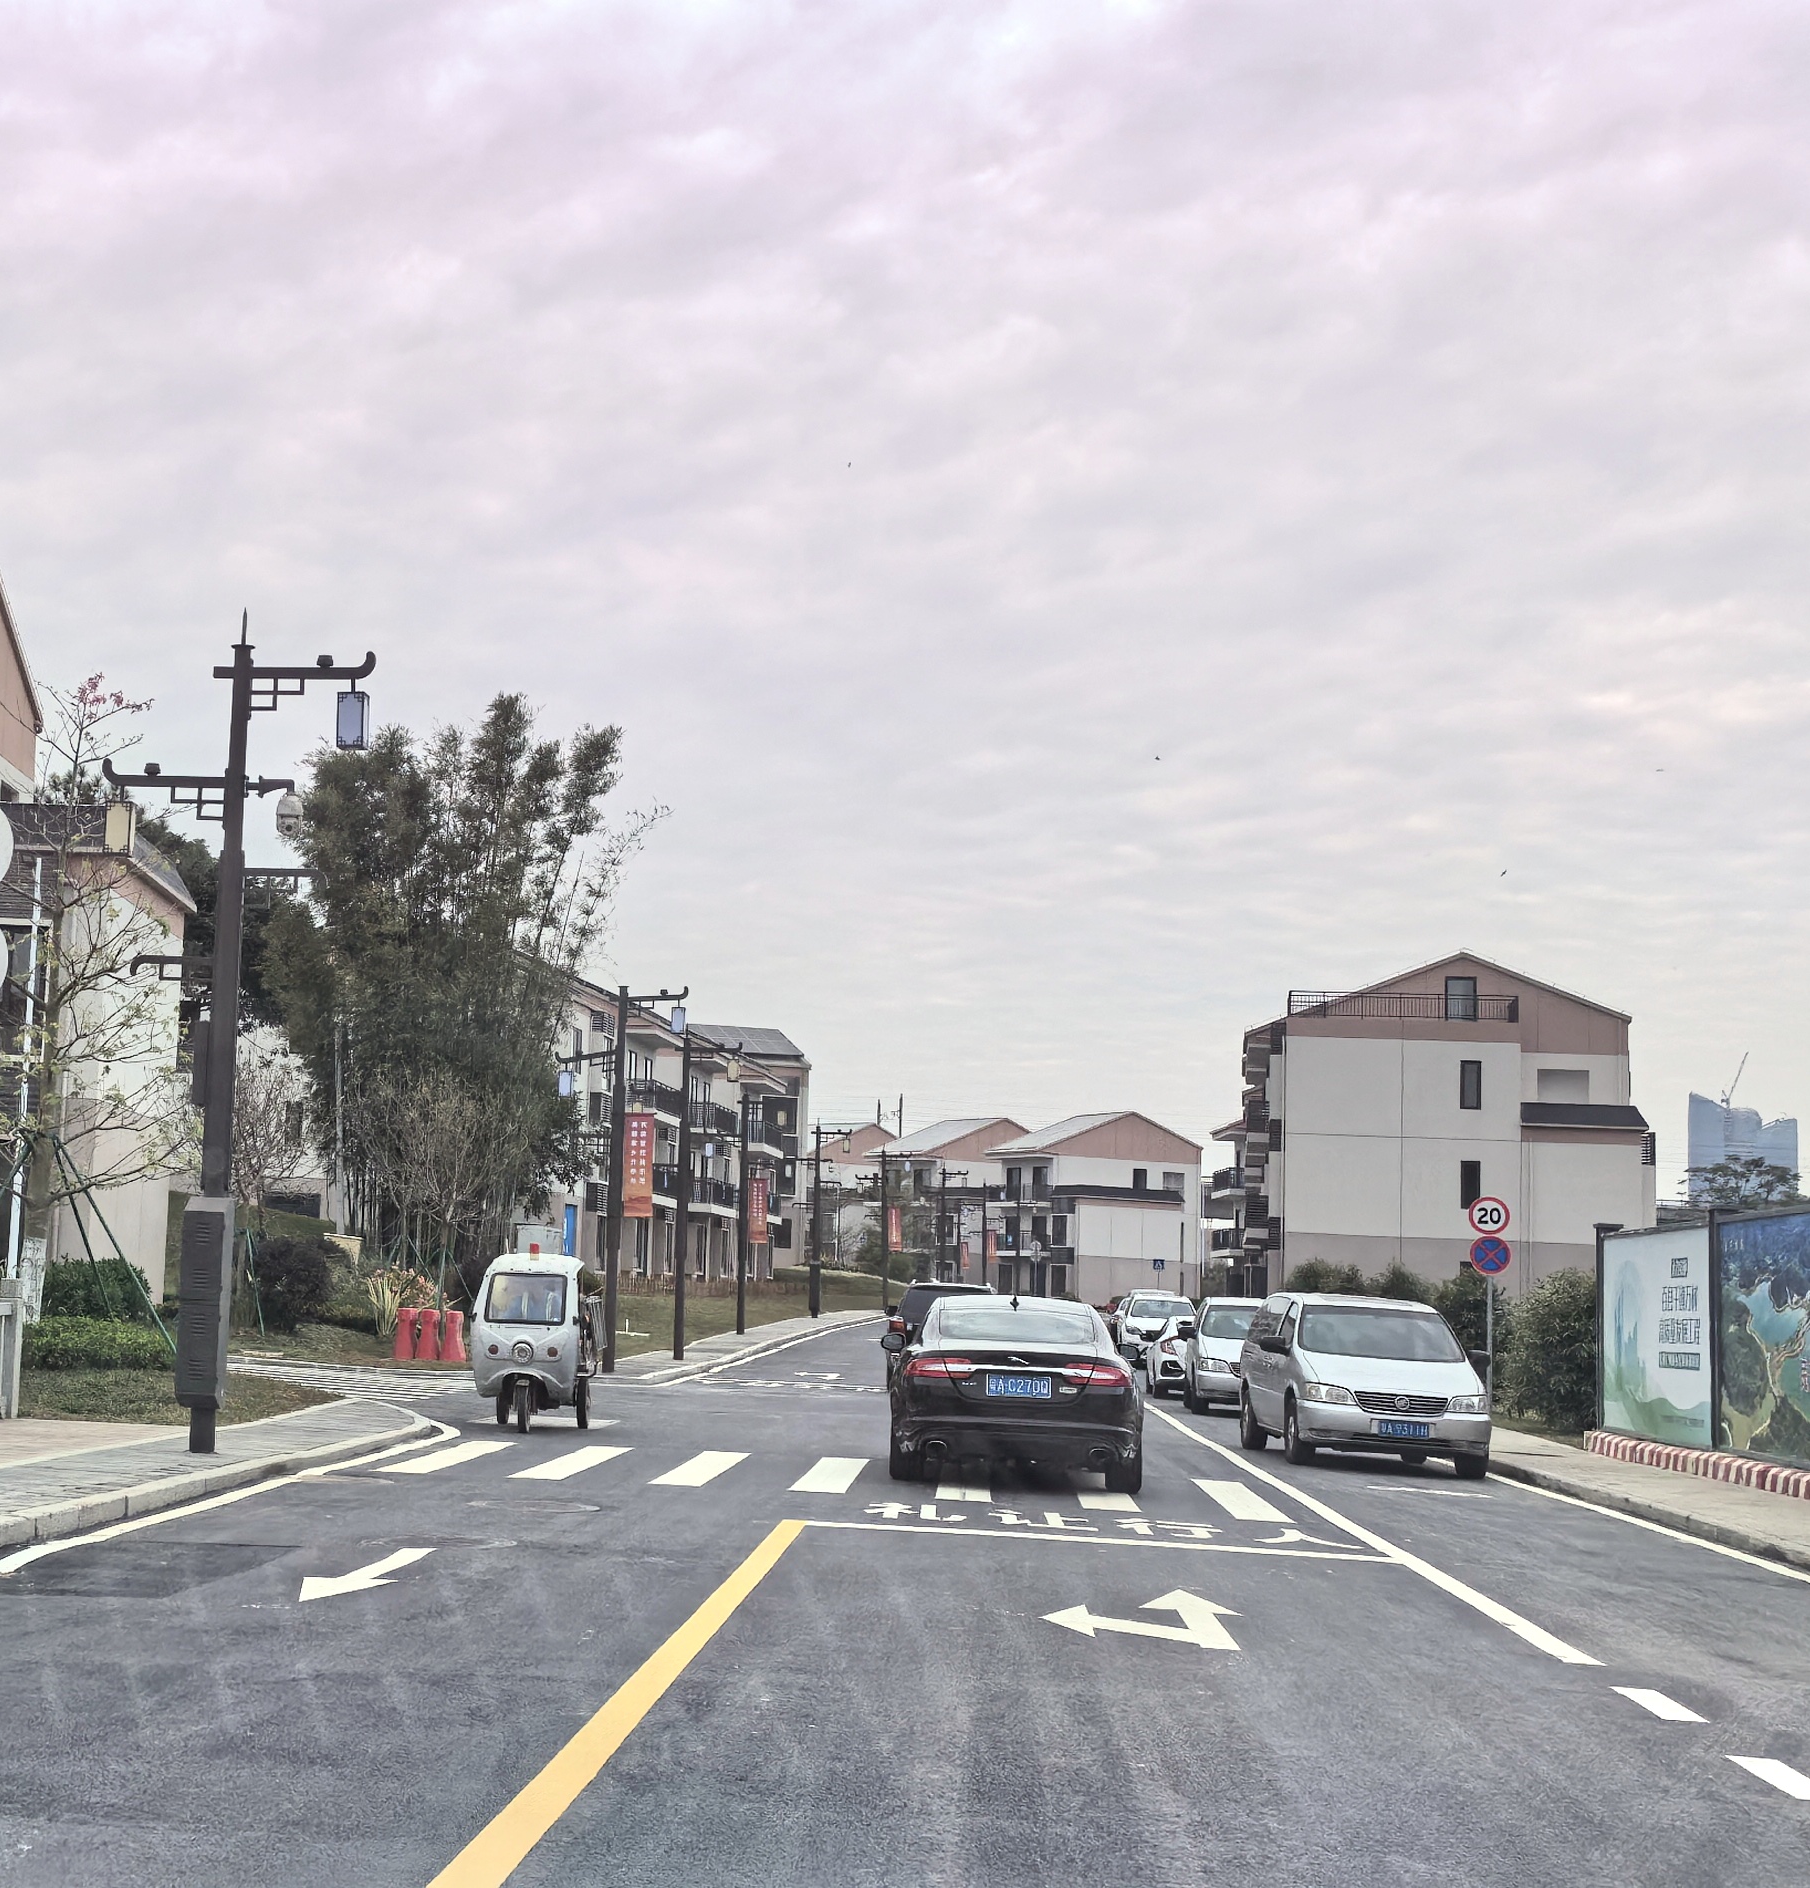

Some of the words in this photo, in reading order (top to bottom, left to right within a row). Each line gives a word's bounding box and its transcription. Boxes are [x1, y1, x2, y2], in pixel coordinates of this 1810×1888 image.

[1477, 1207, 1501, 1225] 20
[863, 1501, 1367, 1550] 礼让行人
